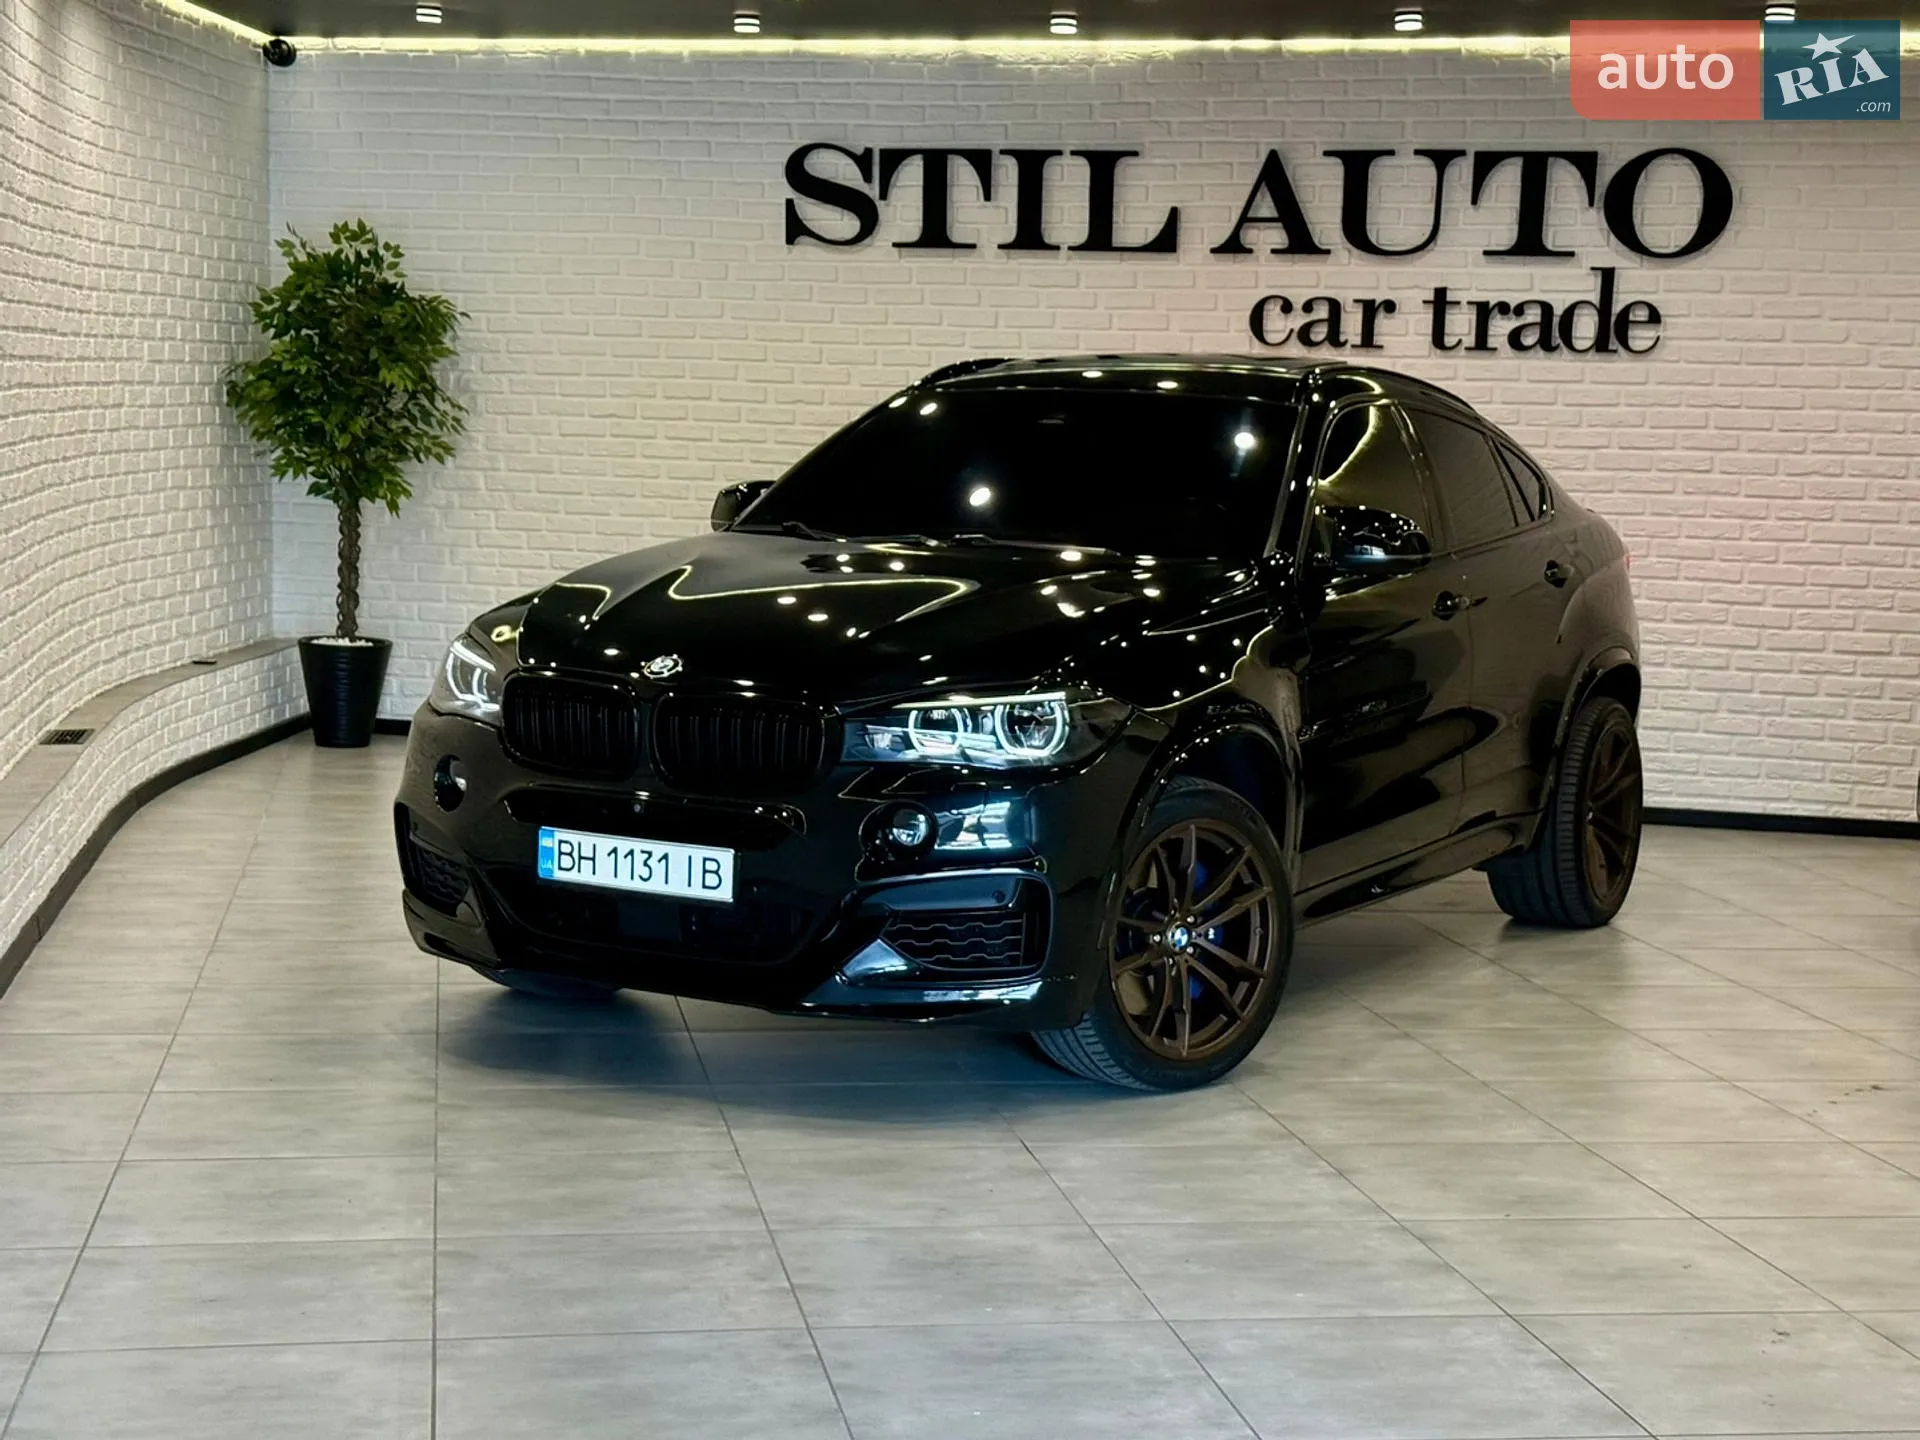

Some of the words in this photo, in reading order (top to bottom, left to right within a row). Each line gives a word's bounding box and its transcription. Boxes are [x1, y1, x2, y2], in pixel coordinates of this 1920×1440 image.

[784, 142, 1179, 253] STIL
[1210, 147, 1734, 259] AUTO
[1249, 294, 1397, 349] car
[1422, 266, 1662, 354] trade
[557, 839, 596, 875] BH
[607, 846, 670, 885] 1131
[687, 855, 723, 890] IB
